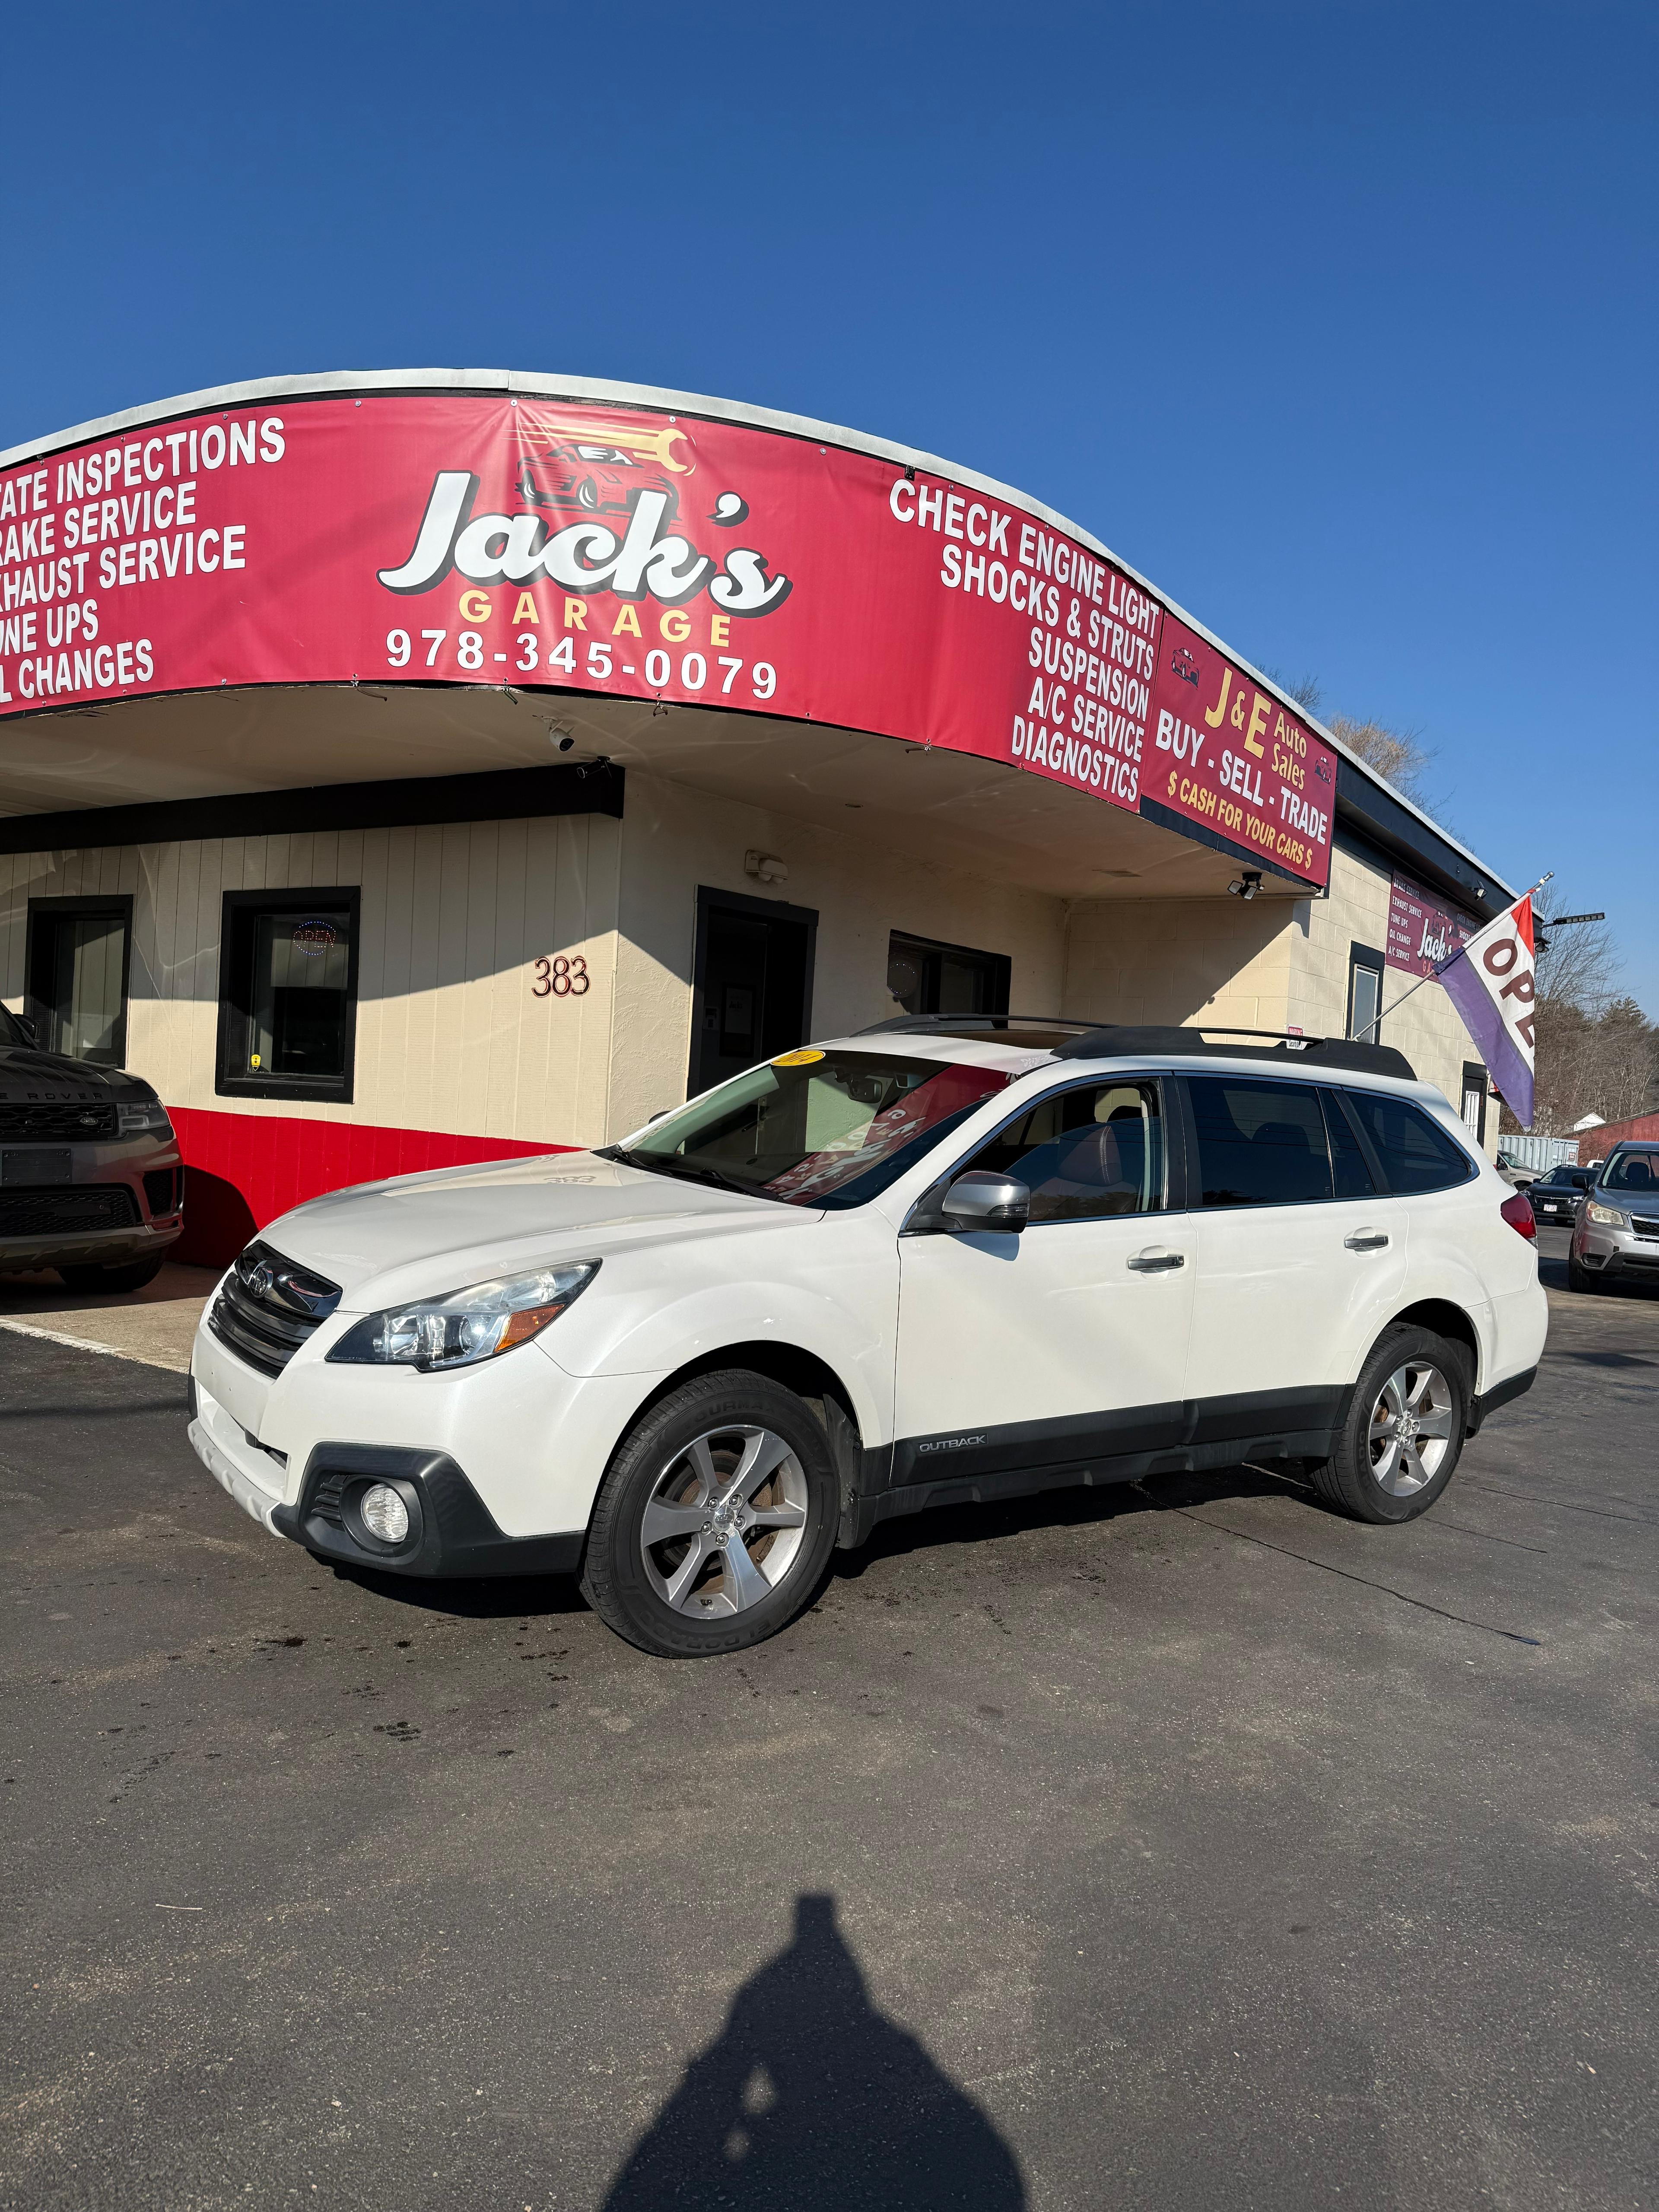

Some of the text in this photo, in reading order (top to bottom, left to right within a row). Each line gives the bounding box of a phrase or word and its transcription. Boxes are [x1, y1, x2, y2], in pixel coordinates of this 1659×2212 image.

[0, 417, 285, 519] ATE INSPECTIONS
[64, 480, 197, 549] SERVICE
[377, 470, 793, 618] Jack's
[99, 524, 246, 589] SERVICE
[889, 478, 1159, 639] CHECK ENGINE LIGHT
[46, 598, 99, 648] UPS
[459, 590, 731, 648] GARAGE
[940, 544, 1153, 681] SHOCKS & STRUTS
[19, 639, 154, 699] CHANGES
[386, 629, 777, 699] 978-345-0079
[1028, 626, 1149, 722] SUSPENSION
[1027, 677, 1144, 763] A/C SERVICE
[1274, 711, 1307, 759] Auto
[1011, 714, 1139, 803] DIAGNOSTICS
[1155, 708, 1205, 768] BUY
[1220, 749, 1264, 808] SELL
[1280, 785, 1328, 845] TRADE
[1271, 742, 1305, 790] Sales
[1168, 770, 1313, 871] $ CASH FOR YOUR CARS $
[1391, 912, 1400, 925] TUNE
[1392, 895, 1422, 918] EXHAUST SERVICE
[1406, 885, 1420, 900] SERVICE
[1396, 931, 1411, 946] CHANGE
[1396, 948, 1409, 962] SERVICE
[531, 955, 591, 998] 383
[920, 1435, 986, 1452] OUTBACK
